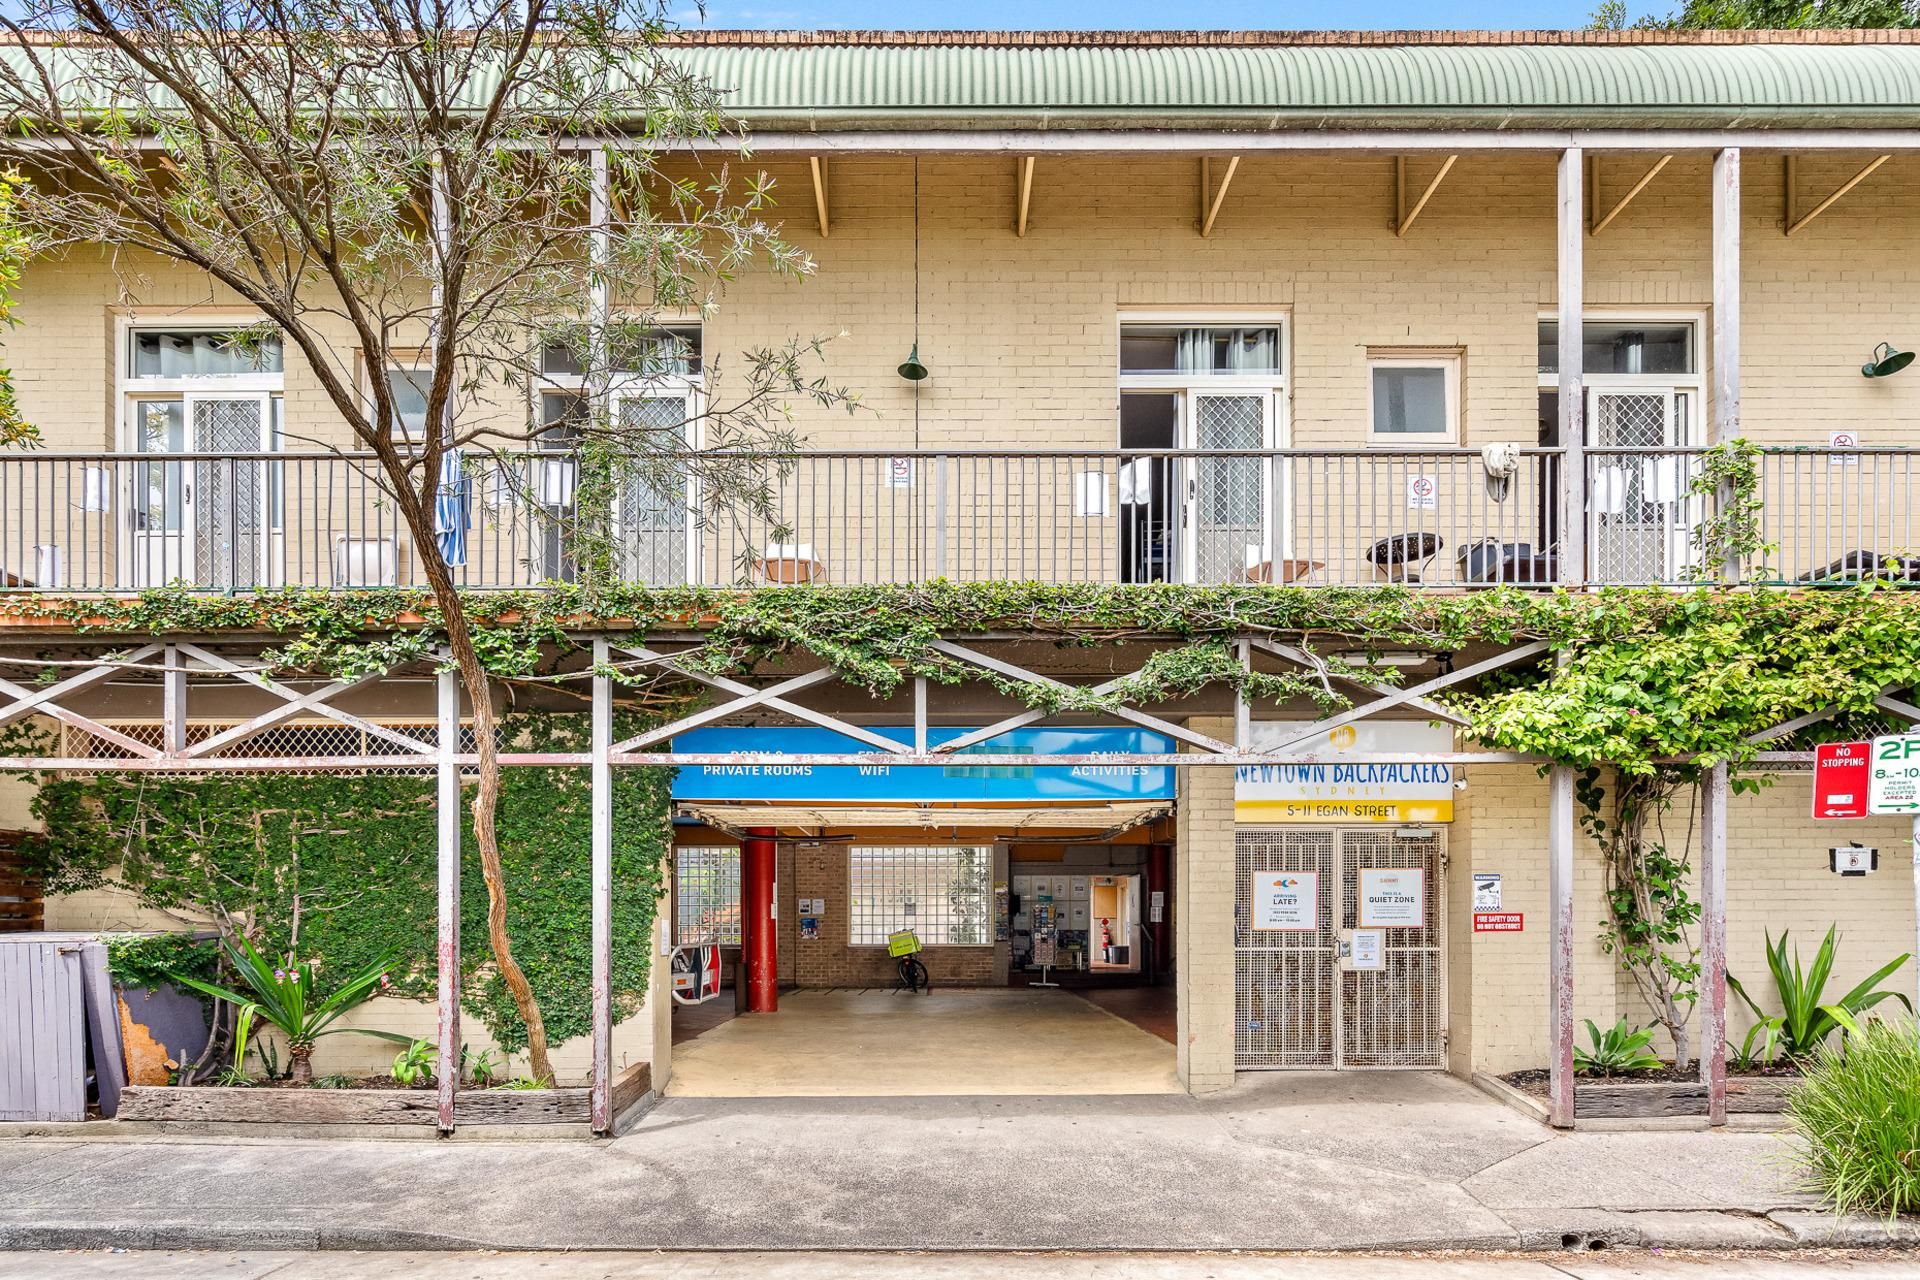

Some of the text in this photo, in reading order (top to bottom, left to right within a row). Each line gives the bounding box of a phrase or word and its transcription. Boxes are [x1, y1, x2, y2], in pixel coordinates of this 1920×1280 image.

[1836, 748, 1851, 757] NO
[1822, 757, 1864, 768] STOPPING
[703, 765, 813, 776] PRIVATE ROOMS
[859, 765, 890, 776] WIFI
[1071, 766, 1149, 776] ACTIVITIES
[1333, 763, 1450, 783] BACKPACKERS
[1287, 804, 1397, 817] 5-11 EGAN STREET
